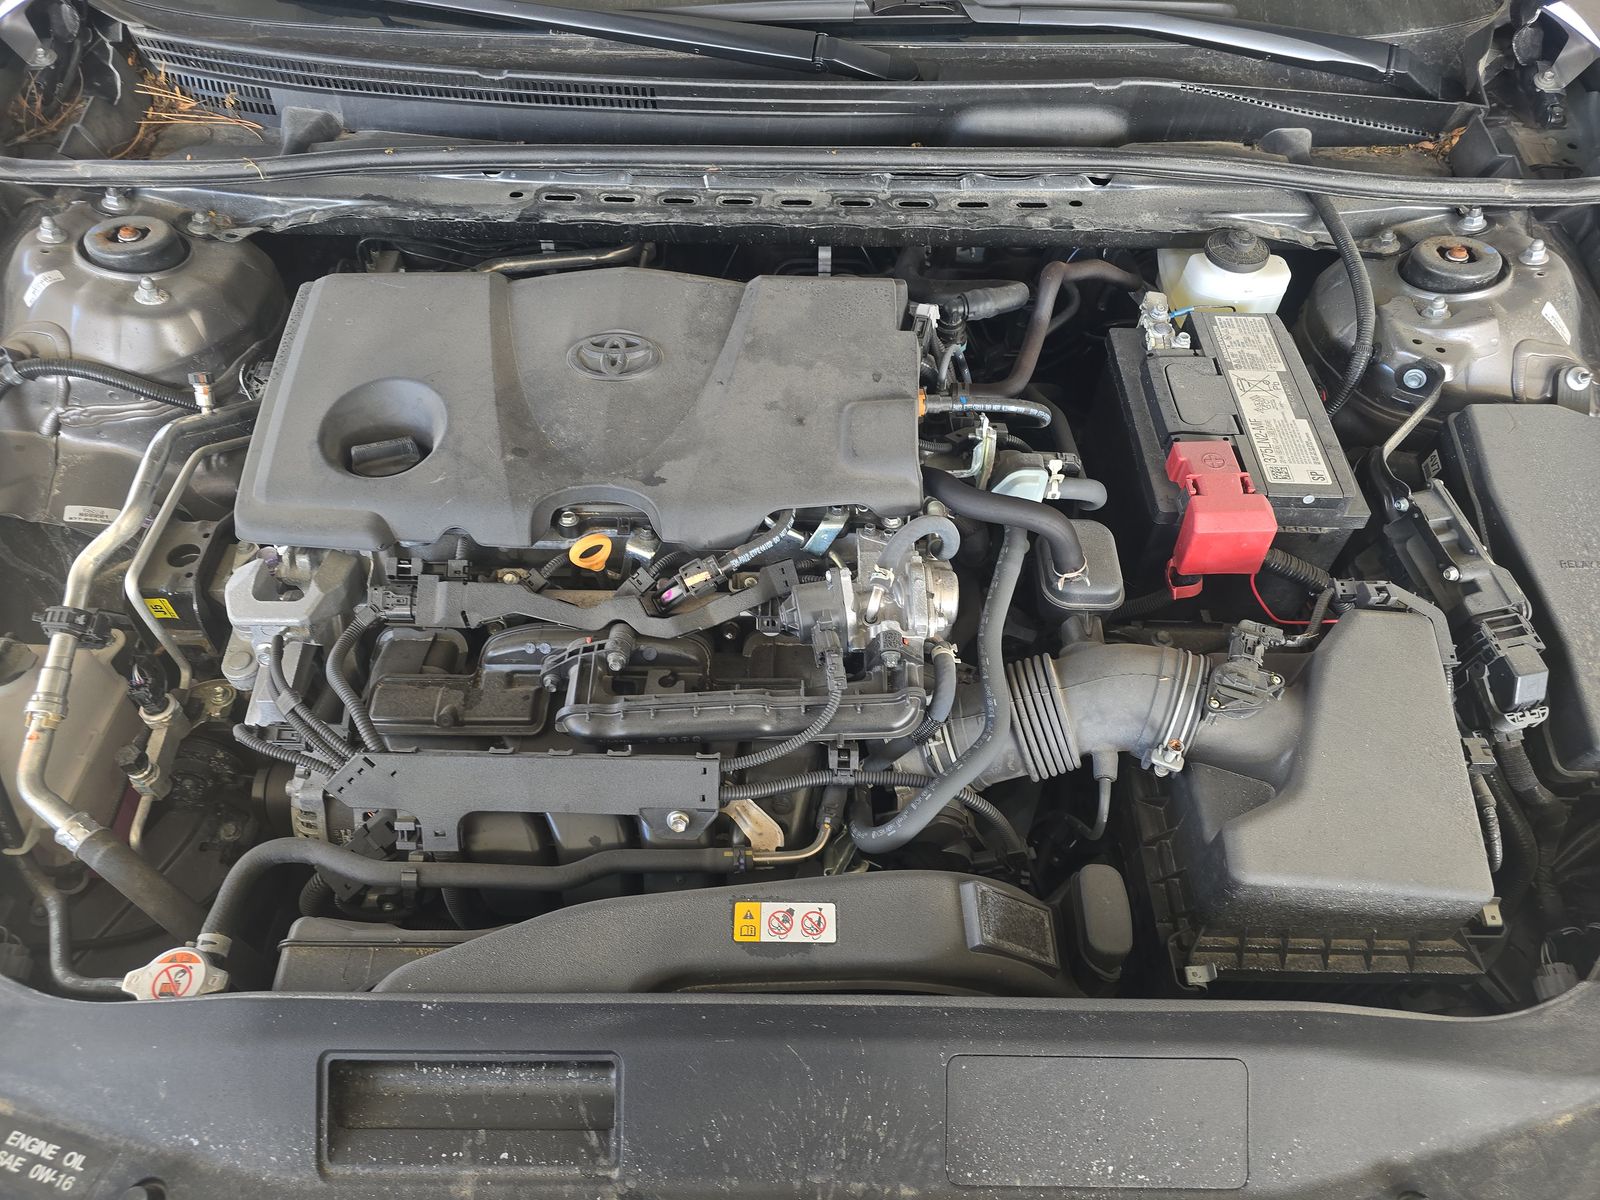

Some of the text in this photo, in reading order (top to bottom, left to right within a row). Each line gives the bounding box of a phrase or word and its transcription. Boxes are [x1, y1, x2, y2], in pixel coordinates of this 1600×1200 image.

[1248, 418, 1277, 464] 375LN2-MF
[1312, 470, 1326, 481] SP
[150, 604, 167, 615] J5
[0, 1150, 76, 1191] SAE 0W-16
[5, 1130, 87, 1171] ENGINE OIL
